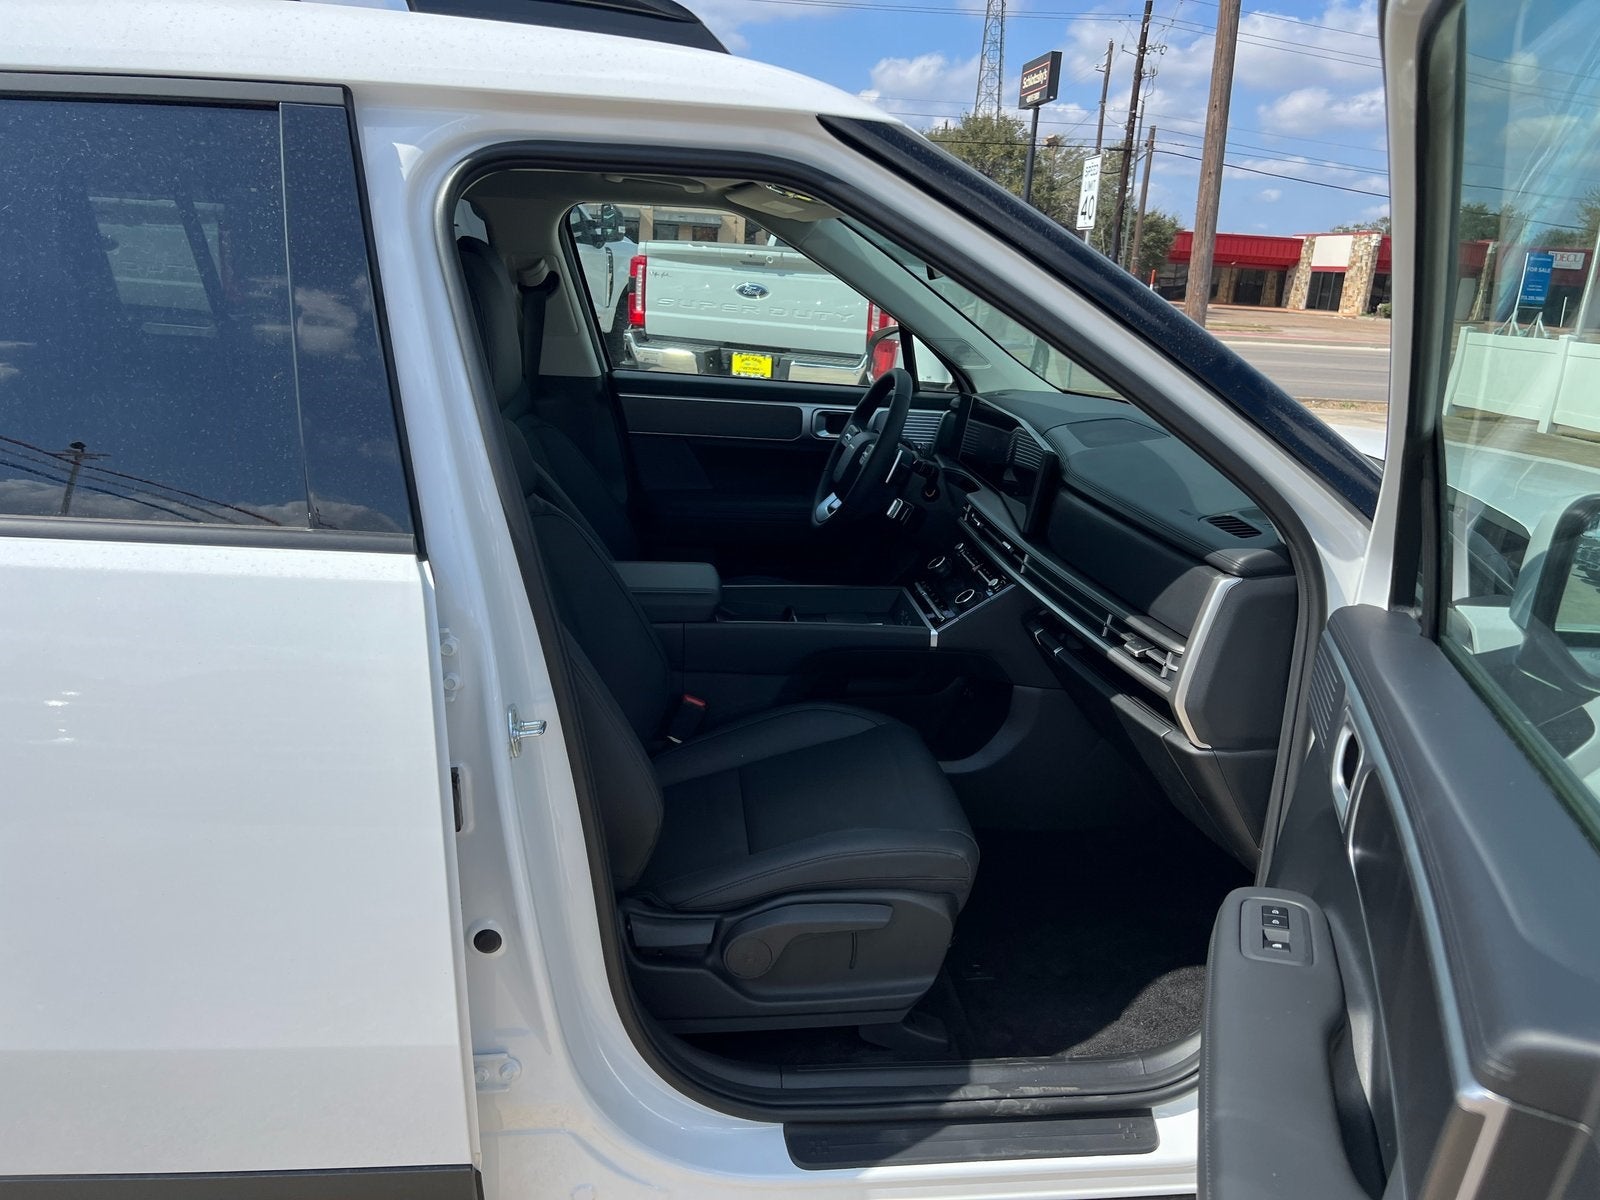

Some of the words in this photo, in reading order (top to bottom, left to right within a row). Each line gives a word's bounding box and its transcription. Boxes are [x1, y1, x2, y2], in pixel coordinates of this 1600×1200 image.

[1084, 164, 1099, 177] SPEED
[1084, 180, 1097, 192] LIMIT
[1081, 195, 1094, 221] 40
[657, 297, 761, 315] SUPER
[769, 307, 855, 323] DUTY
